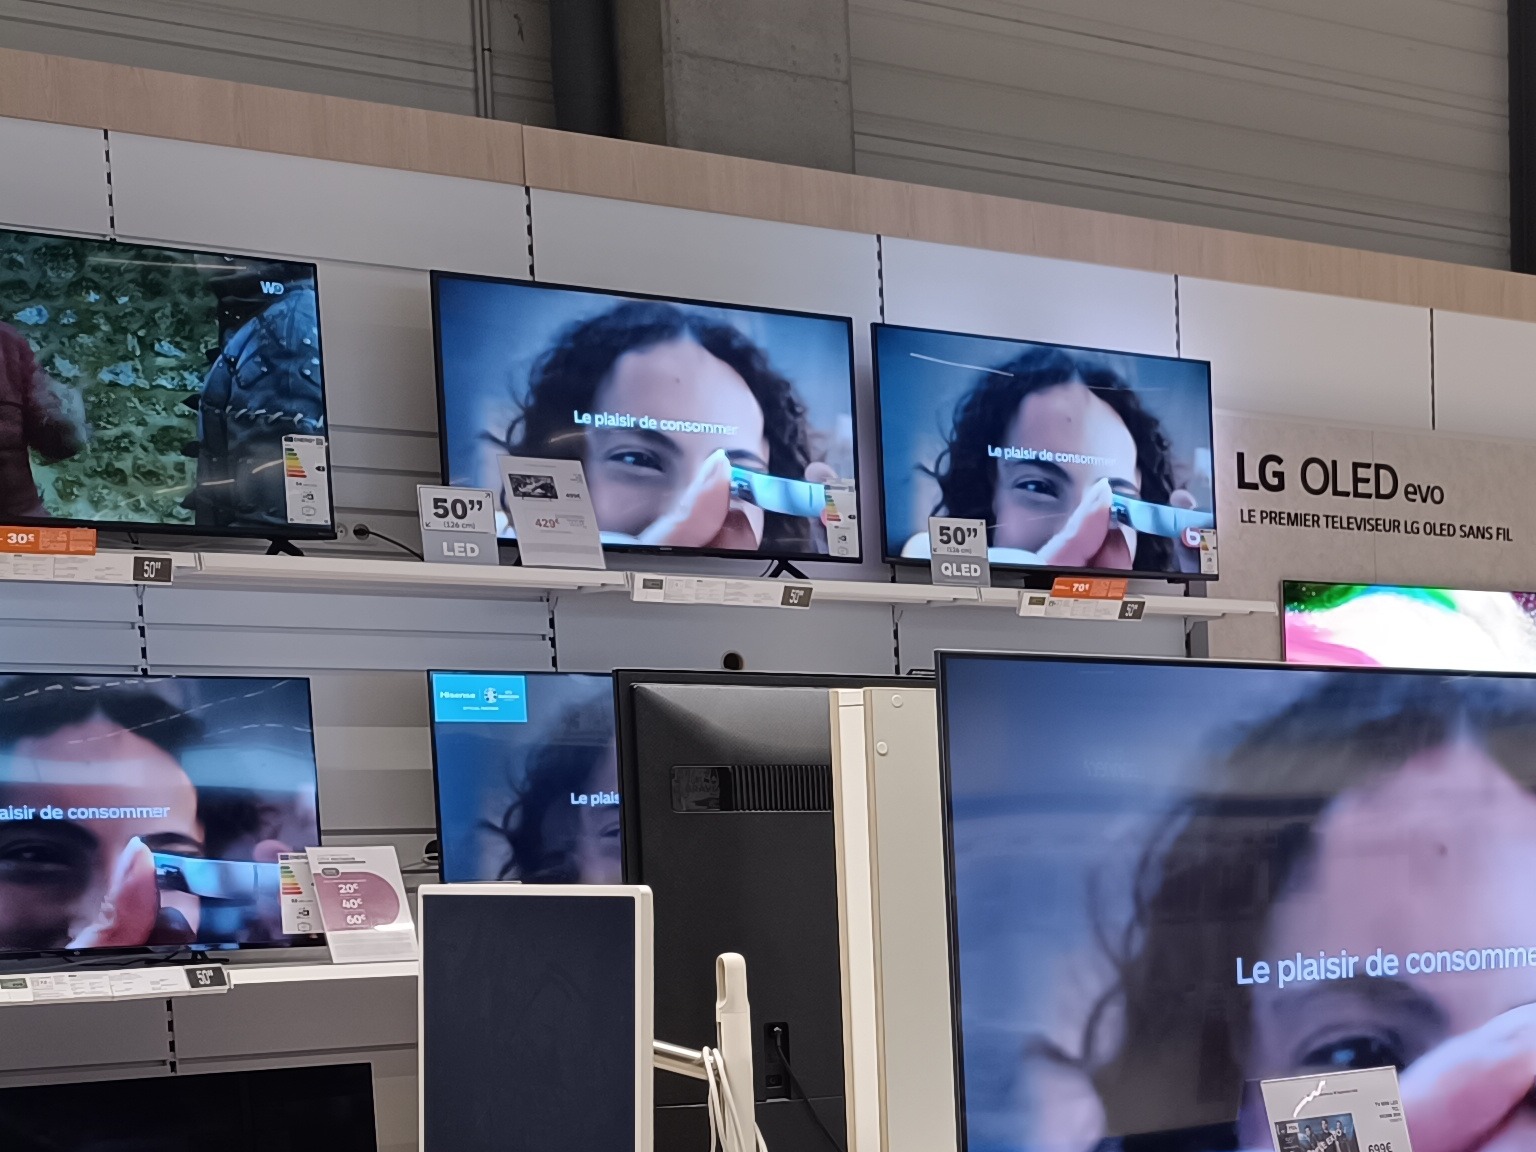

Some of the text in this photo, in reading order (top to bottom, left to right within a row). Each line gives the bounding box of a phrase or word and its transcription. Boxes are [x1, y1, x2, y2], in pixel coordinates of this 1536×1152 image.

[574, 410, 739, 435] Le plaisir de consommer
[988, 445, 1001, 458] Le
[1004, 446, 1037, 460] plaisir
[1039, 449, 1053, 462] de
[1236, 451, 1444, 505] LG OLED evo
[1240, 508, 1513, 542] LE PREMIER TELEVISEUR LG OLED SANS FIL
[443, 541, 480, 557] LED
[941, 562, 980, 577] QLED
[571, 792, 587, 805] Le
[40, 805, 63, 820] de
[68, 807, 170, 819] consommer
[1236, 957, 1270, 985] Le
[1278, 949, 1359, 988] plaisir
[1366, 948, 1399, 977] de
